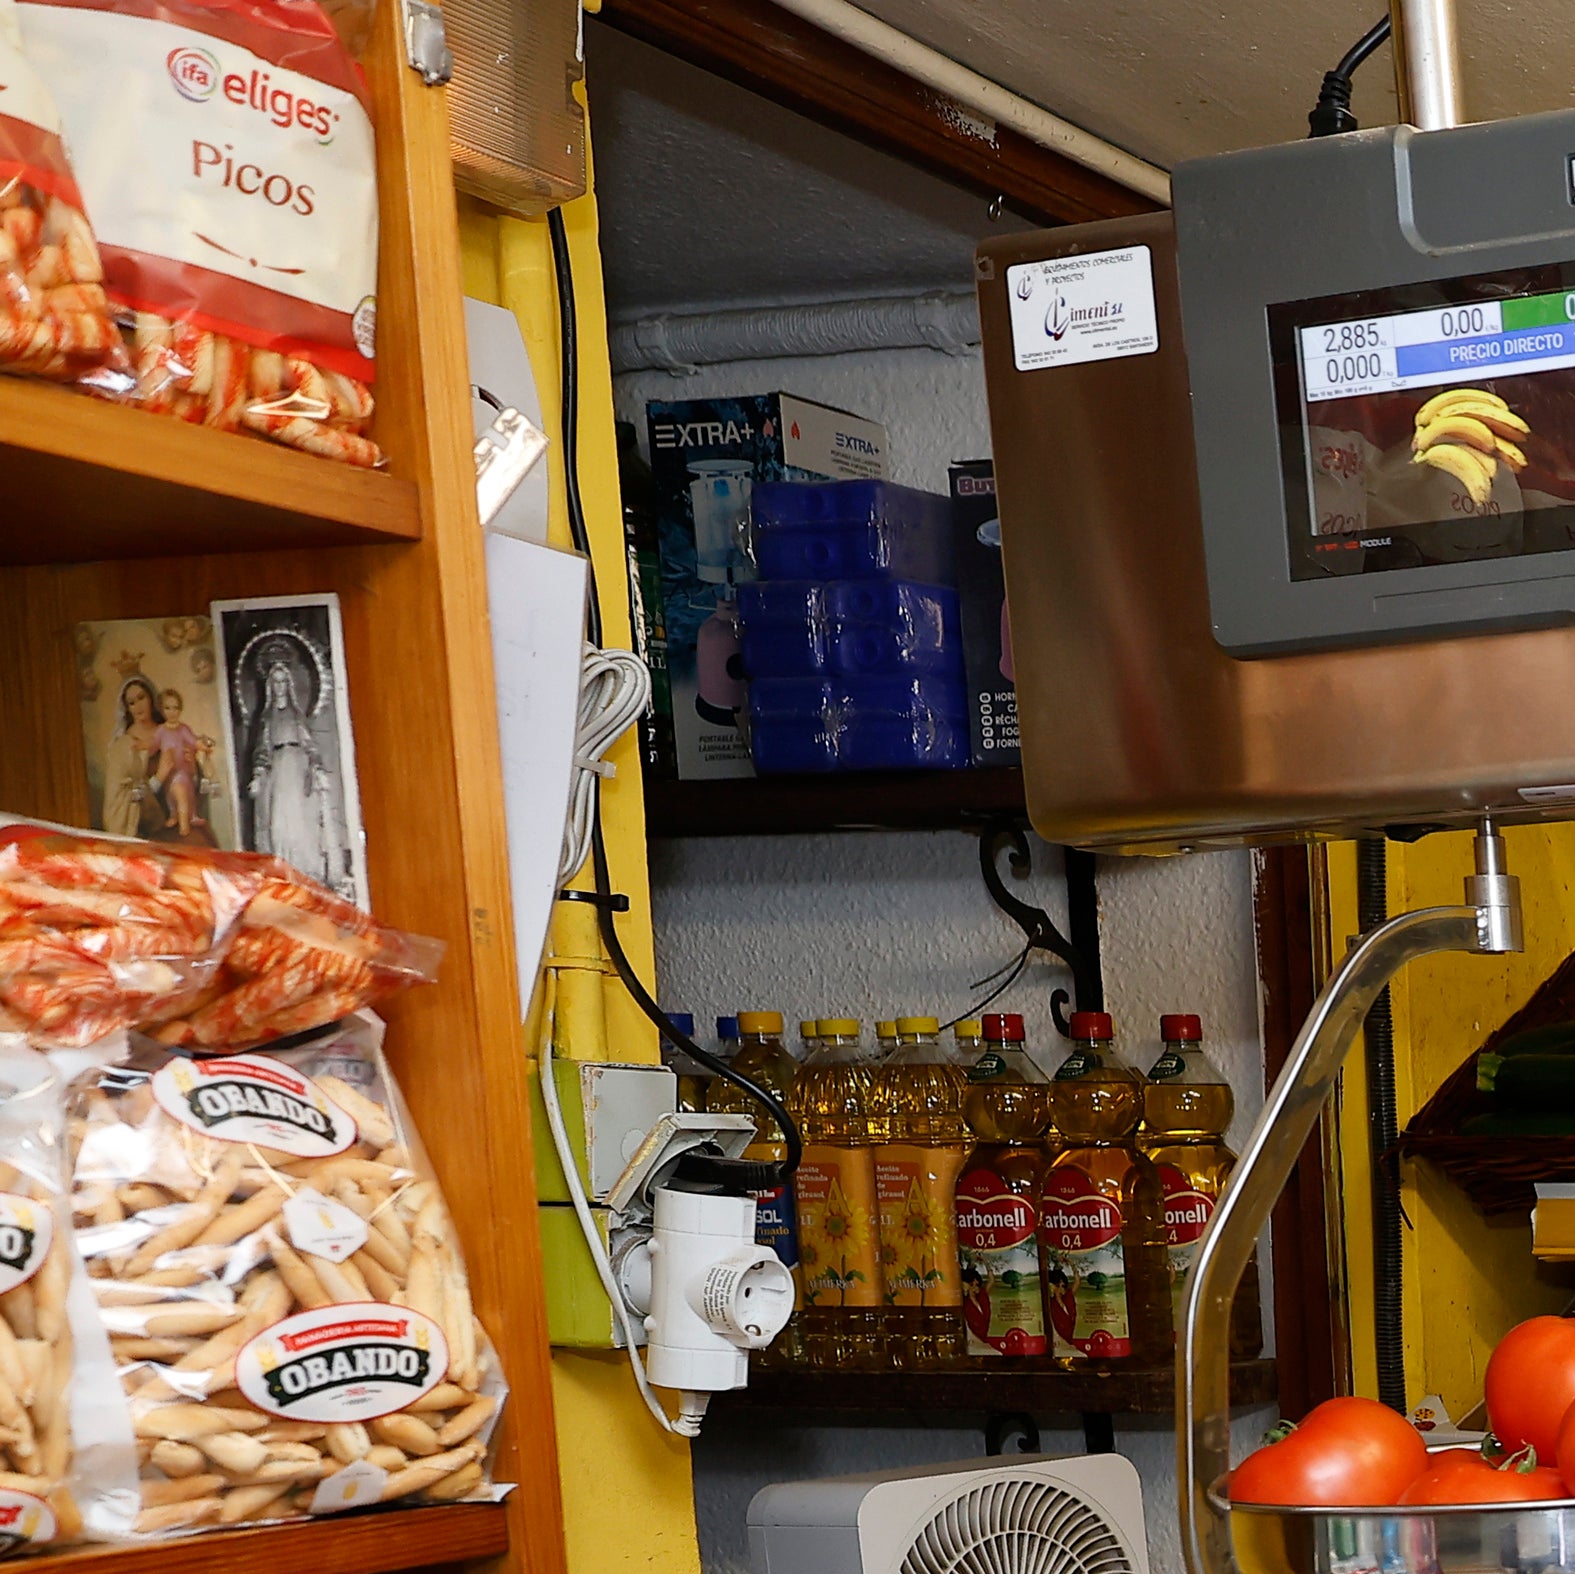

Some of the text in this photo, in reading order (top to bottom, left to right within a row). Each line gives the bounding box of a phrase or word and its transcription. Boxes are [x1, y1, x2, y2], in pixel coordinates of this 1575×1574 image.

[180, 61, 333, 138] ifa eliges
[192, 140, 315, 217] Picos
[1323, 322, 1381, 354] 2,885
[1441, 307, 1485, 338] 0,00
[1449, 332, 1564, 364] PRECIO DIRECTO
[1326, 352, 1383, 386] 0,000
[1360, 537, 1392, 549] MODULE
[197, 1084, 328, 1134] OBANDO
[877, 1190, 905, 1199] girasol
[1045, 1208, 1112, 1231] arbonell
[1164, 1203, 1208, 1224] onell
[975, 1233, 997, 1249] 0,4
[1061, 1234, 1082, 1251] 0,4
[279, 1346, 419, 1396] OBANDO
